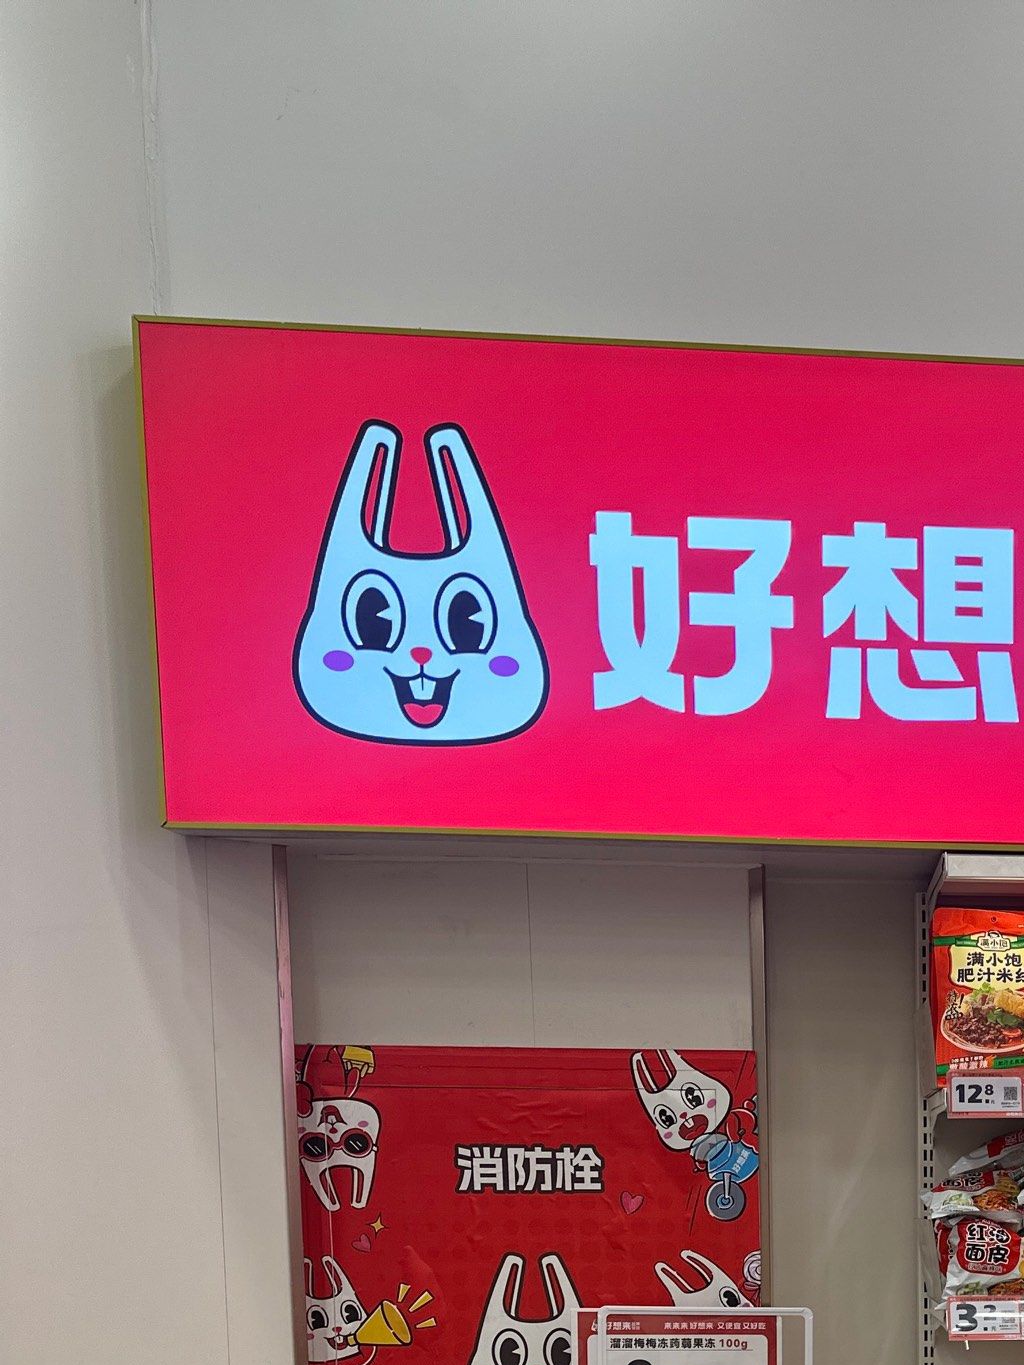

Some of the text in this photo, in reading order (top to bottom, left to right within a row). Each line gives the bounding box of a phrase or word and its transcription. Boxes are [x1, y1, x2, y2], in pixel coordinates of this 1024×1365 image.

[967, 953, 1023, 967] 满小饱
[955, 1084, 994, 1104] 12.8
[456, 1146, 603, 1192] 消防栓
[965, 1243, 1010, 1264] 面皮
[719, 1339, 748, 1350] 100g
